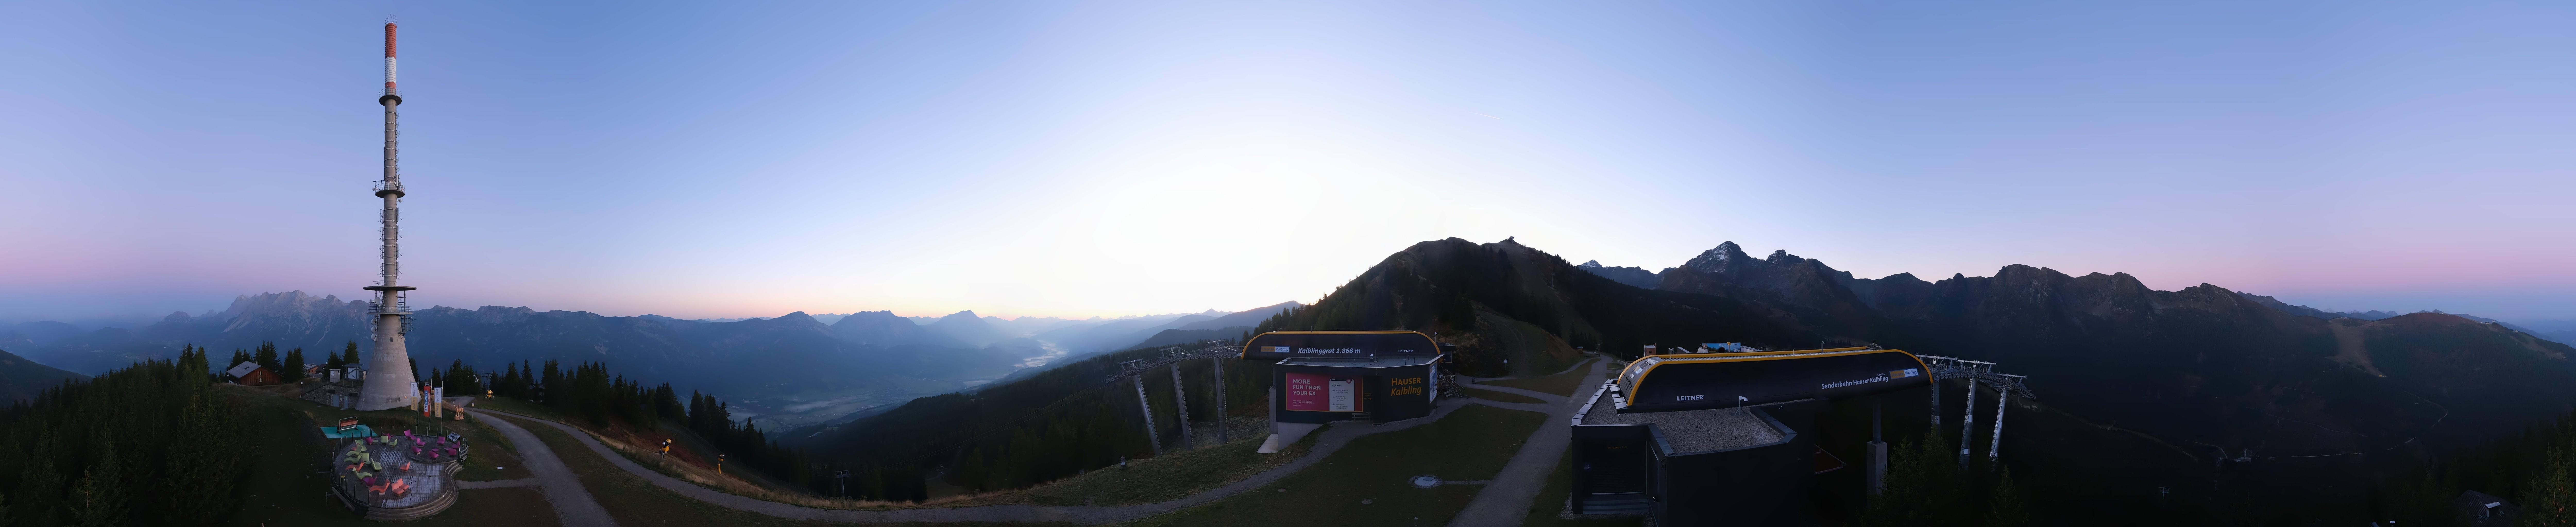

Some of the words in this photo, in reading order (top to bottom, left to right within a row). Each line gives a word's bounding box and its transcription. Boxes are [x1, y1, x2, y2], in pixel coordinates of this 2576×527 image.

[1391, 377, 1421, 386] HAUSER
[1822, 380, 1852, 389] Senderbahn
[1391, 386, 1422, 396] Kaibling
